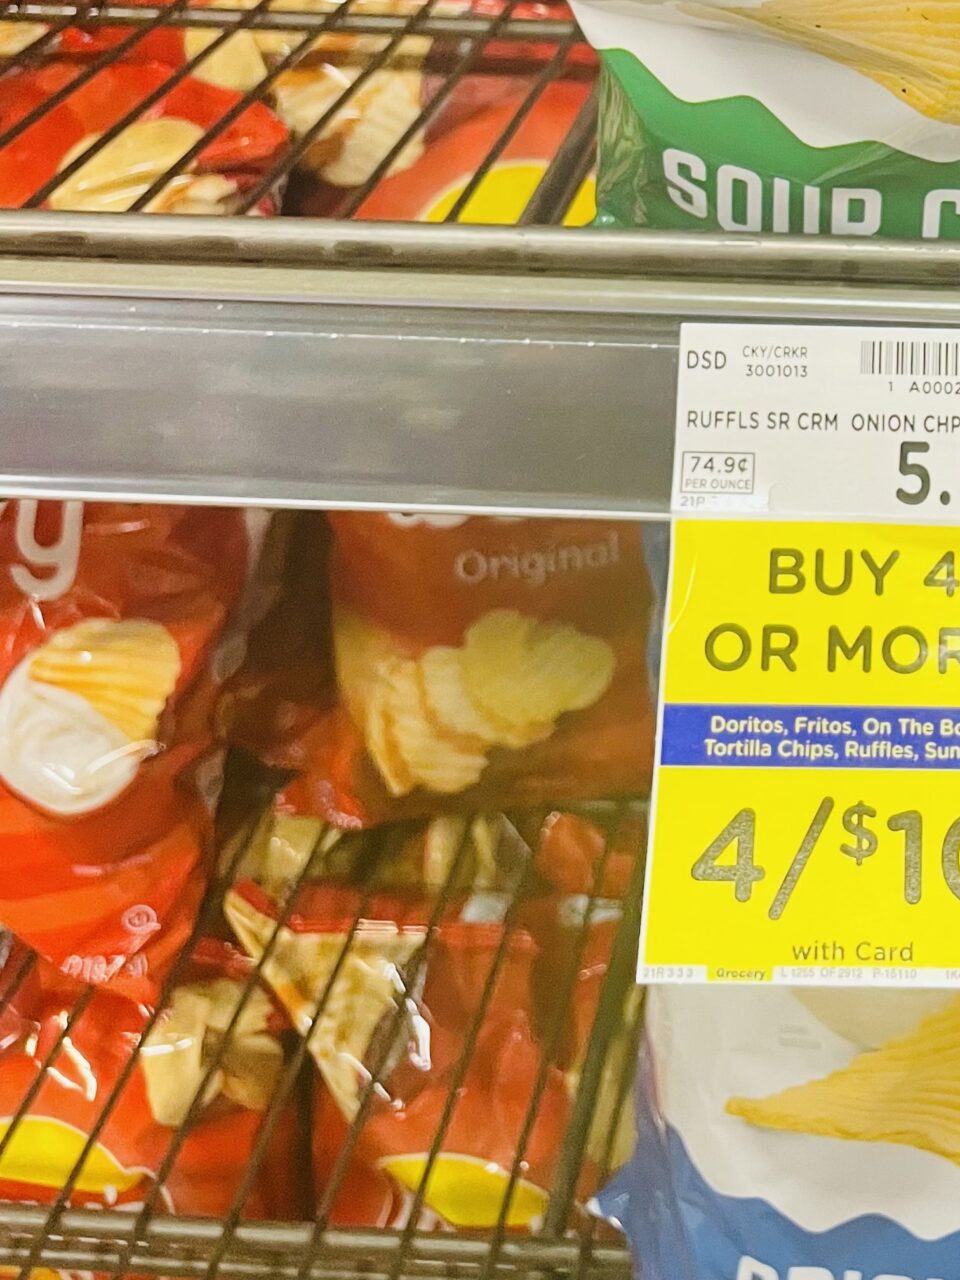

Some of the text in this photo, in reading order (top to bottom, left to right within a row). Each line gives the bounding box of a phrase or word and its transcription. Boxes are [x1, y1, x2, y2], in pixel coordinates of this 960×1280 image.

[687, 345, 808, 370] DSD CKY/CRKR
[746, 363, 808, 378] 3001013
[687, 410, 760, 430] RUFFLS
[767, 412, 790, 431] SR
[797, 412, 839, 431] CRM
[851, 414, 916, 432] ONION
[690, 456, 748, 473] 74.9¢
[685, 478, 751, 489] PER OUNCE
[455, 530, 619, 586] Original
[768, 547, 960, 597] BUY 4
[704, 622, 799, 672] OR
[710, 715, 789, 736] Doritos,
[794, 716, 857, 737] Fritos,
[863, 718, 892, 735] On
[898, 718, 934, 736] The
[704, 738, 772, 757] Tortilla
[778, 740, 839, 760] Chips,
[845, 740, 919, 761] Ruffles,
[792, 941, 914, 963] with Card
[716, 968, 766, 981] Grocery
